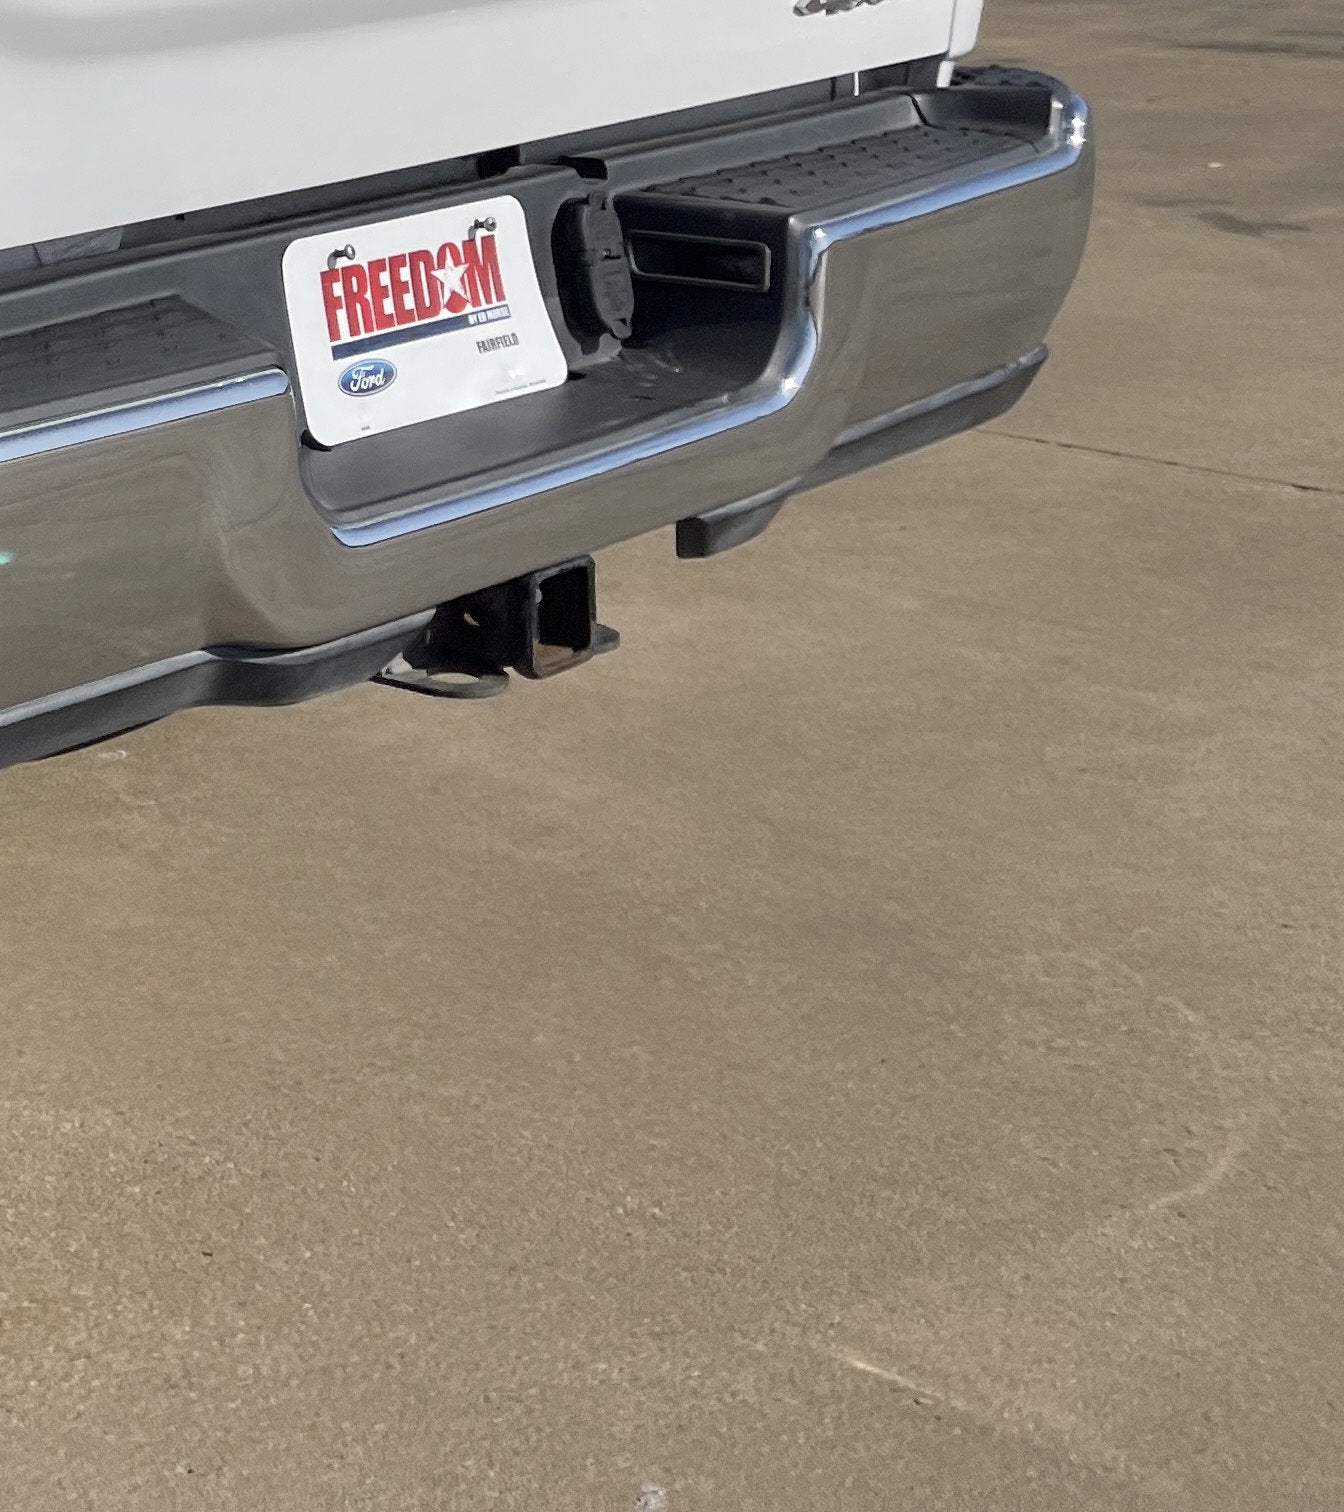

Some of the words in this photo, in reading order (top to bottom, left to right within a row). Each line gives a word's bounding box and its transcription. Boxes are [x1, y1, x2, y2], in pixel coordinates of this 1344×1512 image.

[320, 234, 507, 343] FREEDOM
[476, 332, 520, 354] FAIRFIELD
[350, 364, 386, 392] Ford
